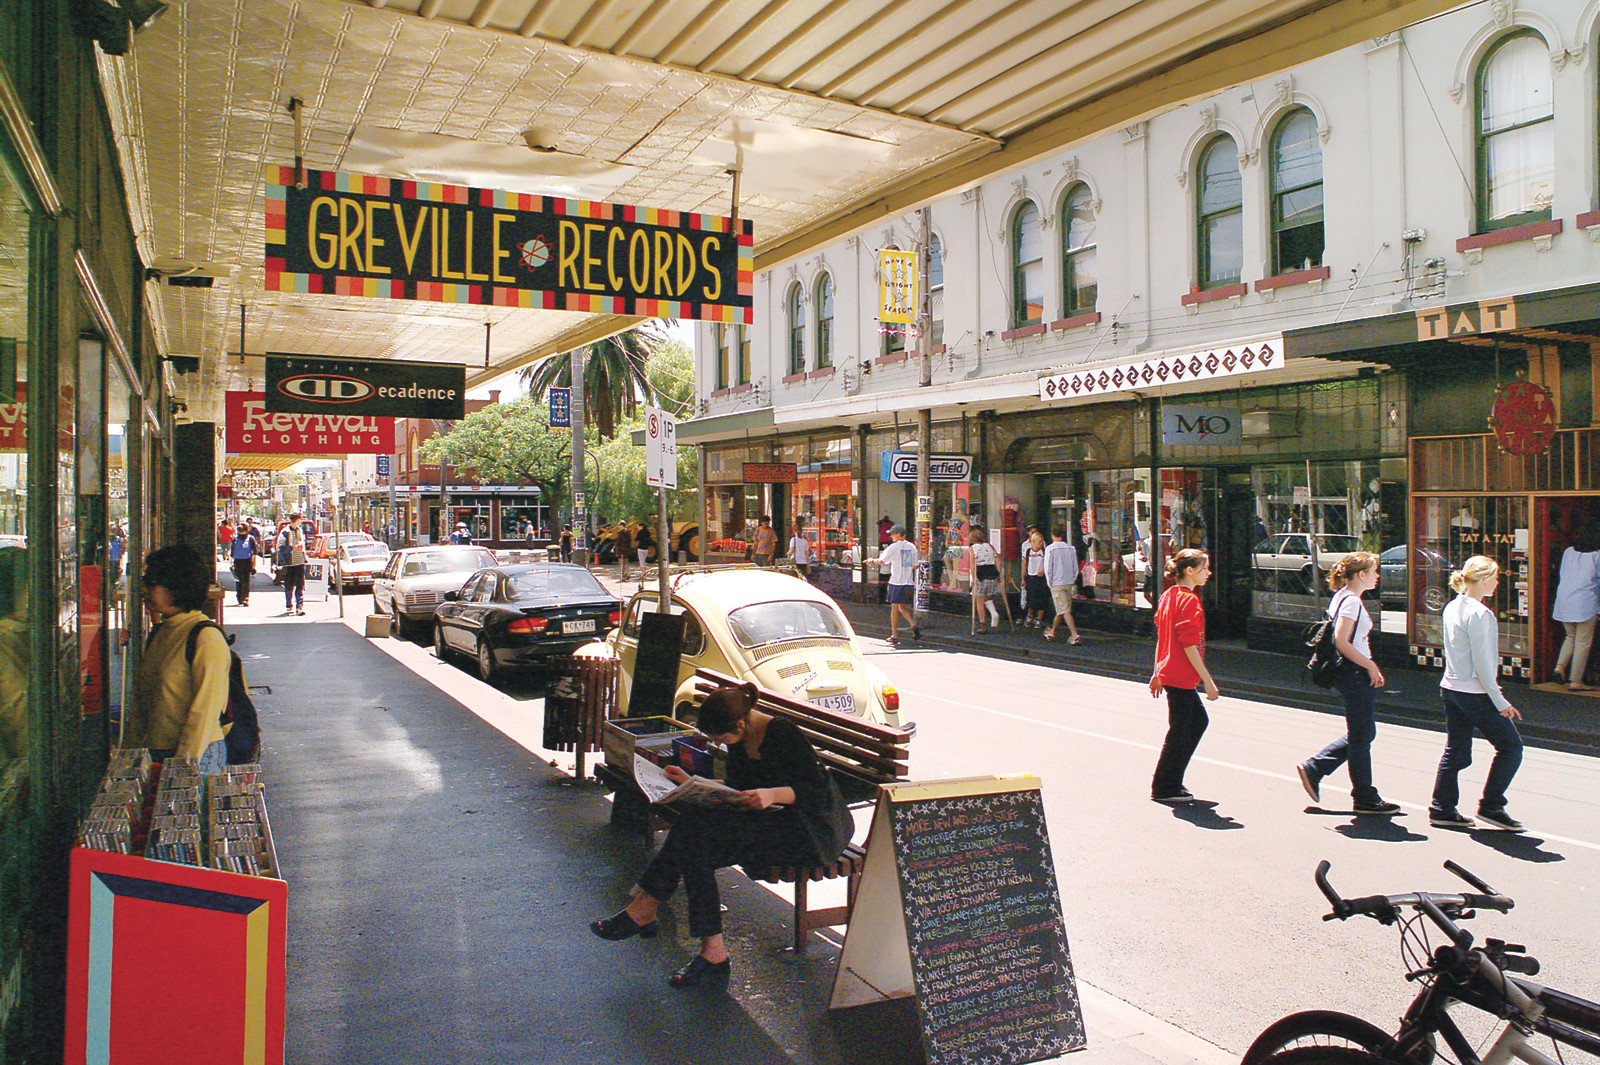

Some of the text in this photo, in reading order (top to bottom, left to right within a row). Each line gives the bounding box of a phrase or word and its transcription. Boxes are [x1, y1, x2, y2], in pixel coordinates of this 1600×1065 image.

[308, 196, 722, 301] GREVILLE RECORDS
[885, 281, 913, 289] BRIGHT
[884, 304, 913, 314] SEASON
[1423, 303, 1508, 337] TAT
[377, 383, 456, 400] ecadence
[663, 420, 674, 438] 1P
[1174, 414, 1231, 435] MO
[242, 433, 381, 445] CLOTHING
[901, 461, 964, 474] Daerfield
[1460, 533, 1516, 544] TAT A TAT
[905, 808, 1018, 833] MORE NEW AND GOOD STUFF
[911, 847, 935, 859] SOUTH
[916, 869, 935, 880] HANK
[937, 864, 969, 877] WILLIAMS
[961, 889, 1000, 907] DYNAMITE
[922, 917, 940, 928] DAVE
[1028, 891, 1049, 902] SHOW
[926, 955, 946, 968] JOHN
[932, 978, 954, 991] FRANK
